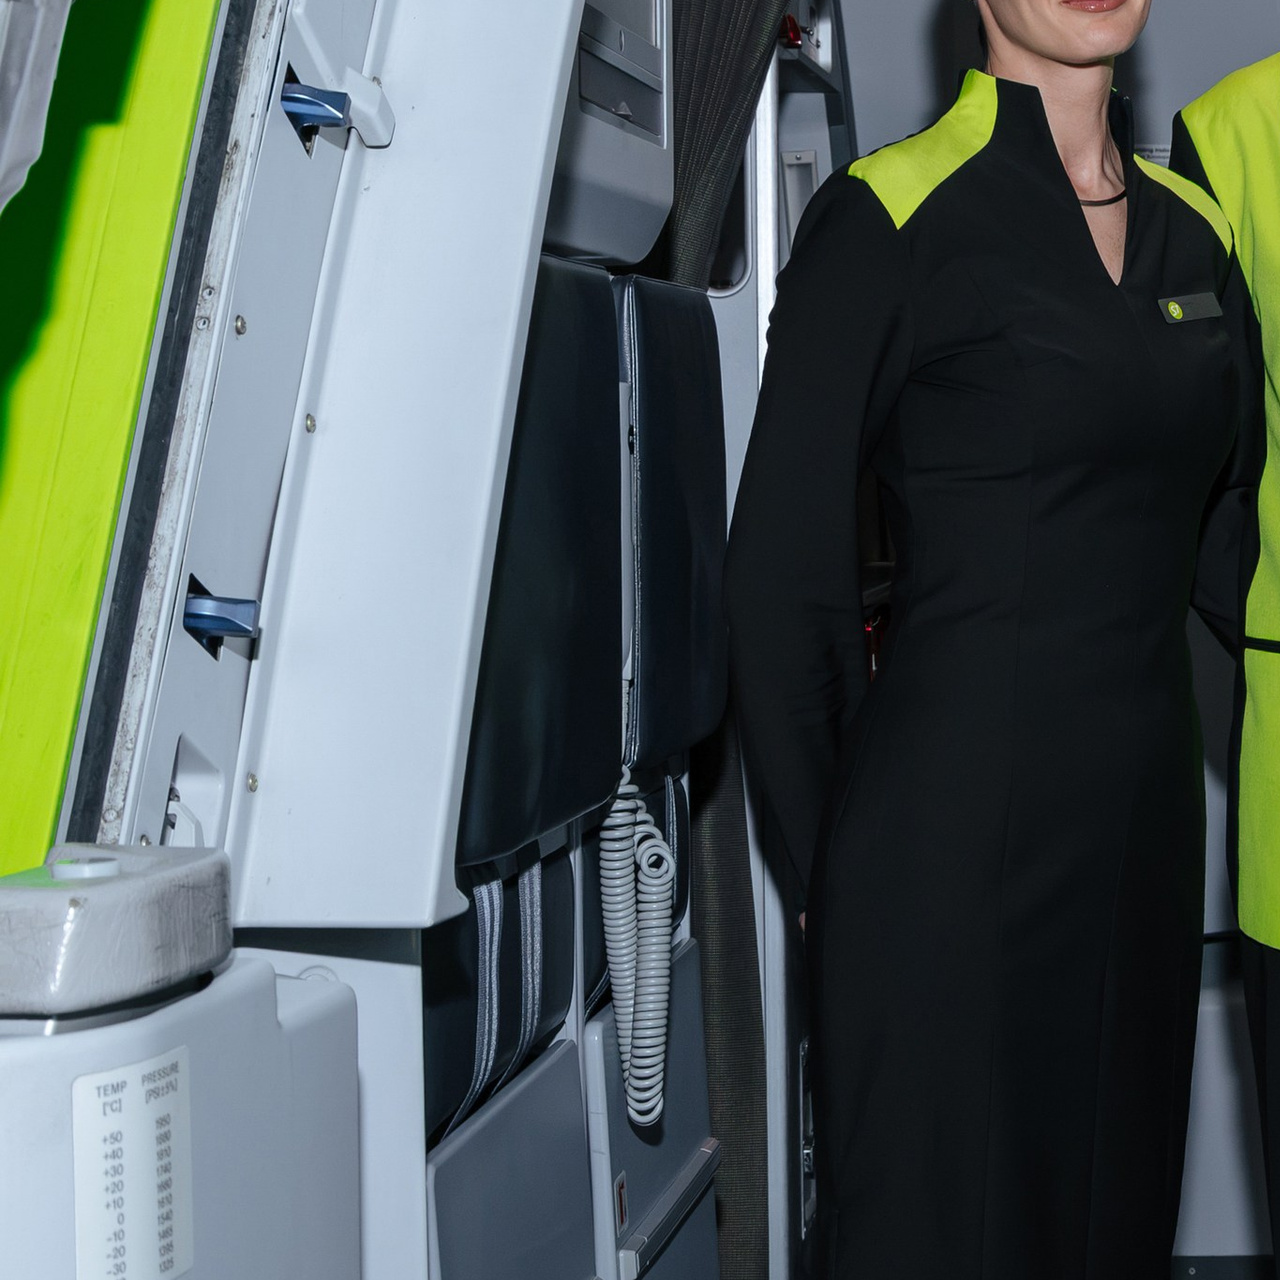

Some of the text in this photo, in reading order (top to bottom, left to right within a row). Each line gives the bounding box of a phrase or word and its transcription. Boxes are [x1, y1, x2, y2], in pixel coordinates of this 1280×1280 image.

[96, 1061, 180, 1098] TEMP PRESSURE
[103, 1131, 122, 1145] +50
[103, 1148, 123, 1160] +40
[104, 1164, 124, 1177] +30
[104, 1180, 124, 1193] +20
[105, 1197, 124, 1210] +10
[117, 1214, 124, 1225] 0
